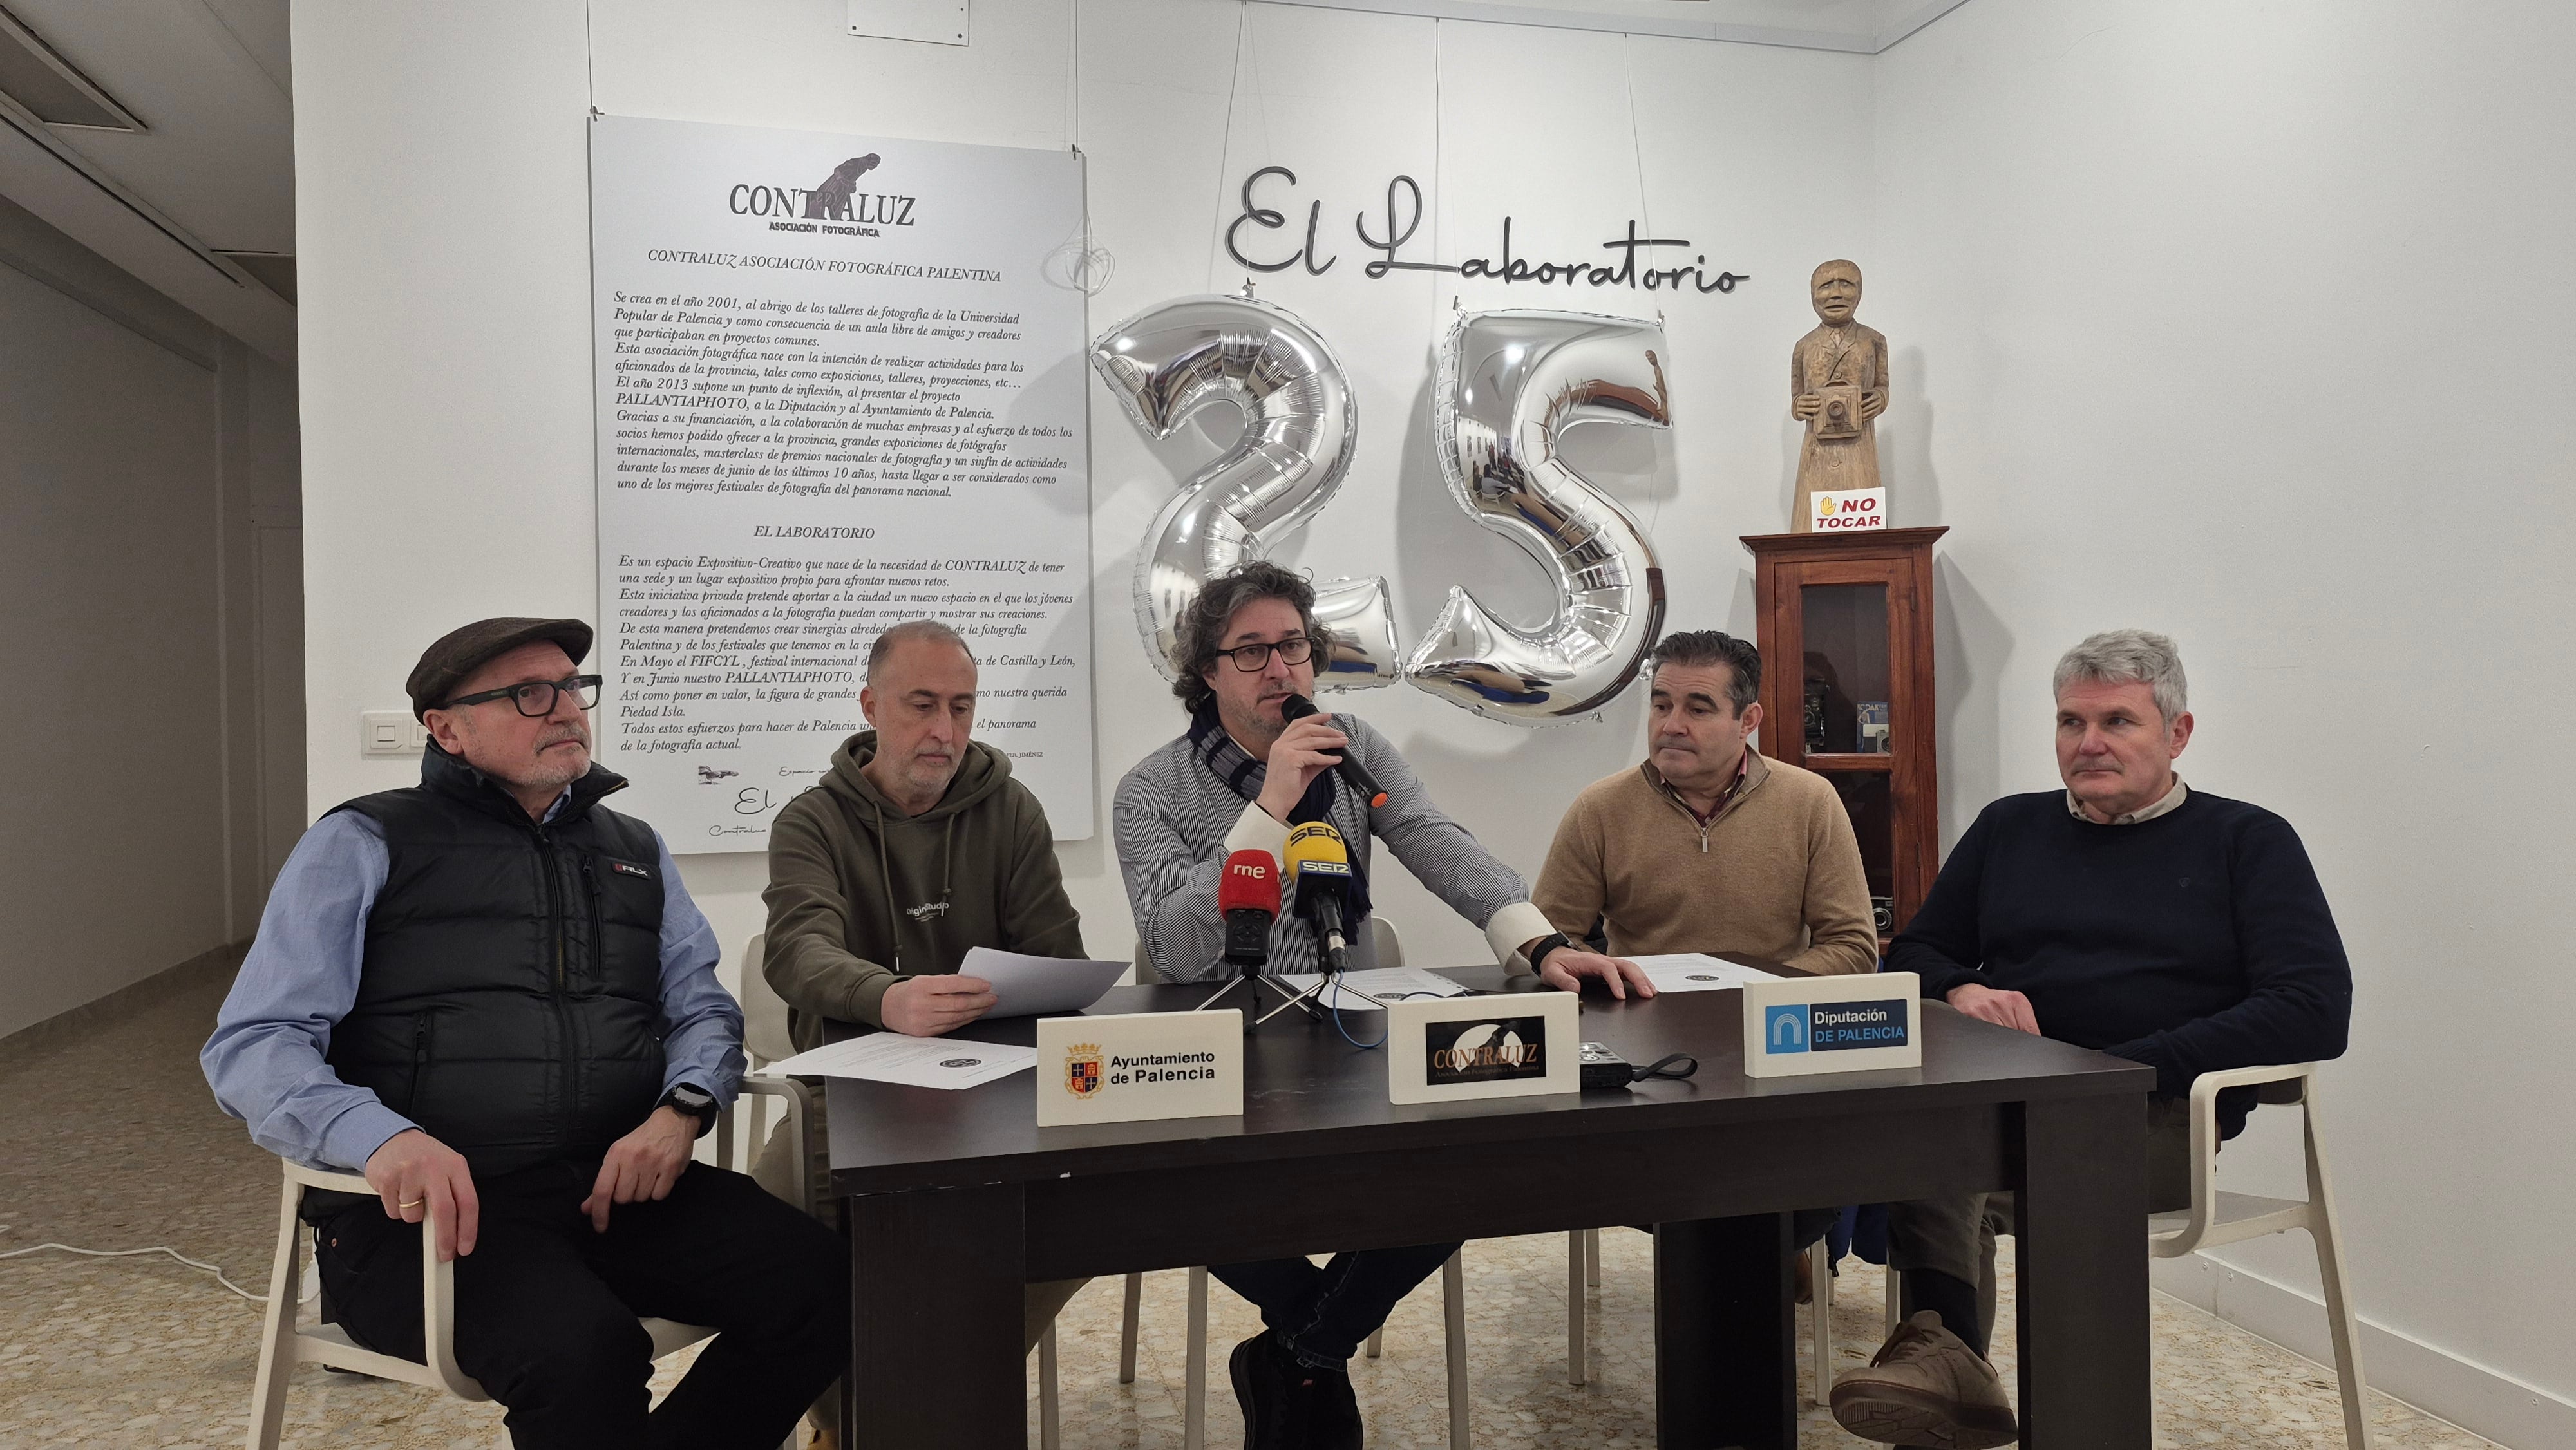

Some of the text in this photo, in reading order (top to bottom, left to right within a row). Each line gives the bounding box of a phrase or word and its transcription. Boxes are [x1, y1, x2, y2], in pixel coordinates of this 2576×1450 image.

[730, 184, 916, 226] CONTRALUZ
[769, 221, 881, 238] ASOCIACIÓN FOTOGRÁFICA
[1226, 166, 1751, 294] El Laboratorio
[648, 249, 1001, 282] CONTRALUZ ASOCIACIÓN FOTOGRÁFICA PALENTINA
[614, 290, 627, 303] Se
[629, 295, 652, 304] crea
[655, 296, 667, 305] en
[670, 294, 681, 306] el
[683, 296, 703, 306] año
[706, 296, 741, 311] 2001,
[745, 298, 757, 310] al
[759, 299, 791, 315] abrigo
[795, 301, 807, 312] de
[811, 302, 824, 314] los
[828, 303, 864, 315] talleres
[867, 305, 878, 316] de
[932, 309, 943, 320] de
[947, 309, 956, 321] la
[961, 310, 1019, 324] Universidad
[613, 308, 658, 323] Popular
[661, 310, 674, 322] de
[676, 311, 723, 325] Palencia
[723, 317, 732, 328] y
[735, 318, 762, 326] como
[766, 319, 831, 330] consecuencia
[834, 319, 846, 331] de
[865, 322, 887, 334] aula
[891, 323, 914, 335] libre
[916, 324, 928, 335] de
[931, 325, 965, 340] amigos
[965, 330, 974, 341] y
[977, 328, 1021, 340] creadores
[614, 328, 633, 340] que
[634, 326, 705, 343] participaban
[722, 332, 771, 346] proyectos
[774, 337, 819, 346] comunes.
[614, 359, 675, 373] aficionados
[679, 361, 690, 373] de
[694, 362, 705, 373] la
[706, 364, 759, 379] provincia,
[764, 366, 788, 377] tales
[791, 370, 817, 379] como
[820, 369, 884, 384] exposiciones,
[888, 372, 925, 386] talleres,
[929, 374, 991, 389] proyecciones,
[615, 392, 749, 411] PALLANTIAPHOTO,
[764, 399, 775, 410] la
[777, 399, 836, 415] Diputación
[836, 405, 846, 416] y
[849, 402, 860, 413] al
[862, 402, 931, 417] Ayuntamiento
[935, 406, 946, 417] de
[949, 406, 994, 419] Palencia.
[616, 426, 647, 438] socios
[650, 428, 684, 440] hemos
[685, 429, 723, 444] podido
[726, 430, 761, 445] ofrecer
[773, 432, 784, 443] la
[786, 433, 837, 447] provincia,
[840, 435, 880, 449] grandes
[883, 437, 943, 450] exposiciones
[945, 438, 957, 449] de
[956, 438, 1007, 453] fotógrafos
[617, 480, 637, 489] uno
[641, 477, 653, 489] de
[656, 478, 672, 489] los
[674, 478, 714, 493] mejores
[713, 480, 764, 494] festivales
[767, 481, 779, 493] de
[834, 483, 850, 494] del
[851, 485, 904, 498] panorama
[907, 485, 951, 497] nacional.
[1842, 498, 1877, 513] NO
[1817, 516, 1881, 528] TOCAR
[753, 525, 875, 539] EL LABORATORIO
[618, 554, 634, 566] Es
[637, 558, 651, 567] un
[655, 556, 693, 570] espacio
[696, 556, 801, 570] Expositivo-Creativo
[805, 561, 823, 572] que
[852, 558, 864, 569] de
[867, 558, 876, 569] la
[880, 559, 928, 570] necesidad
[930, 560, 942, 570] de
[945, 560, 1027, 574] CONTRALUZ
[1028, 561, 1039, 572] de
[1042, 563, 1065, 572] tener
[643, 572, 665, 583] sede
[665, 576, 674, 587] y
[696, 572, 724, 587] lugar
[727, 572, 777, 587] expositivo
[779, 574, 813, 588] propio
[815, 576, 841, 588] para
[844, 574, 886, 588] afrontar
[925, 577, 949, 587] retos.
[620, 672, 631, 683] Y
[646, 672, 680, 687] Junio
[683, 673, 721, 683] nuestro
[724, 671, 854, 684] PALLANTIAPHOTO,
[994, 686, 1067, 700] nuestra querida
[620, 705, 685, 717] Piedad Isla.
[976, 718, 1036, 731] el panorama
[620, 739, 632, 751] de
[636, 739, 647, 751] la
[706, 737, 741, 749] actual.
[1290, 826, 1343, 847] SER
[1234, 863, 1266, 880] rne
[1303, 862, 1350, 874] SER
[1814, 1008, 1887, 1026] Diputación
[1815, 1026, 1904, 1043] DE PALENCIA
[1110, 1051, 1215, 1069] Ayuntamiento
[1434, 1044, 1538, 1069] CONTRALUZ
[1111, 1066, 1215, 1084] de Palencia
